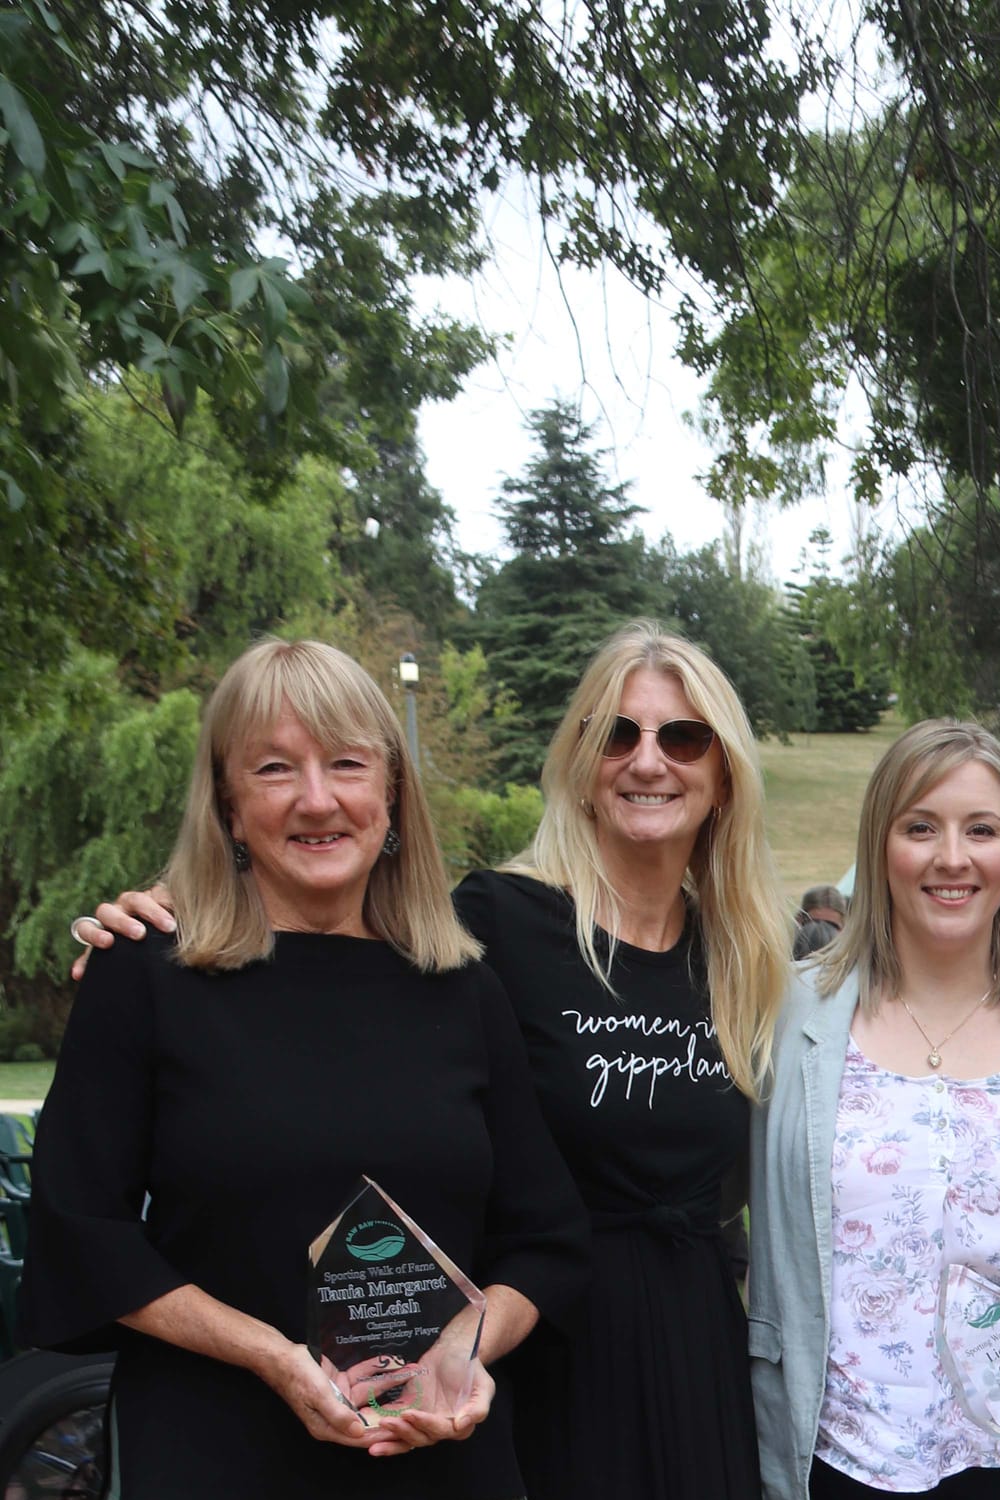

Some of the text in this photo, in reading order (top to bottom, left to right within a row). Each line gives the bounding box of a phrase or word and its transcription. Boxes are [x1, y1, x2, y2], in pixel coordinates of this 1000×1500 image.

[562, 1010, 691, 1037] women
[586, 1033, 735, 1110] gippslan
[323, 1262, 436, 1284] Sporting Walk of Fame
[317, 1275, 447, 1302] Tania Margaret
[347, 1299, 421, 1320] McLeish
